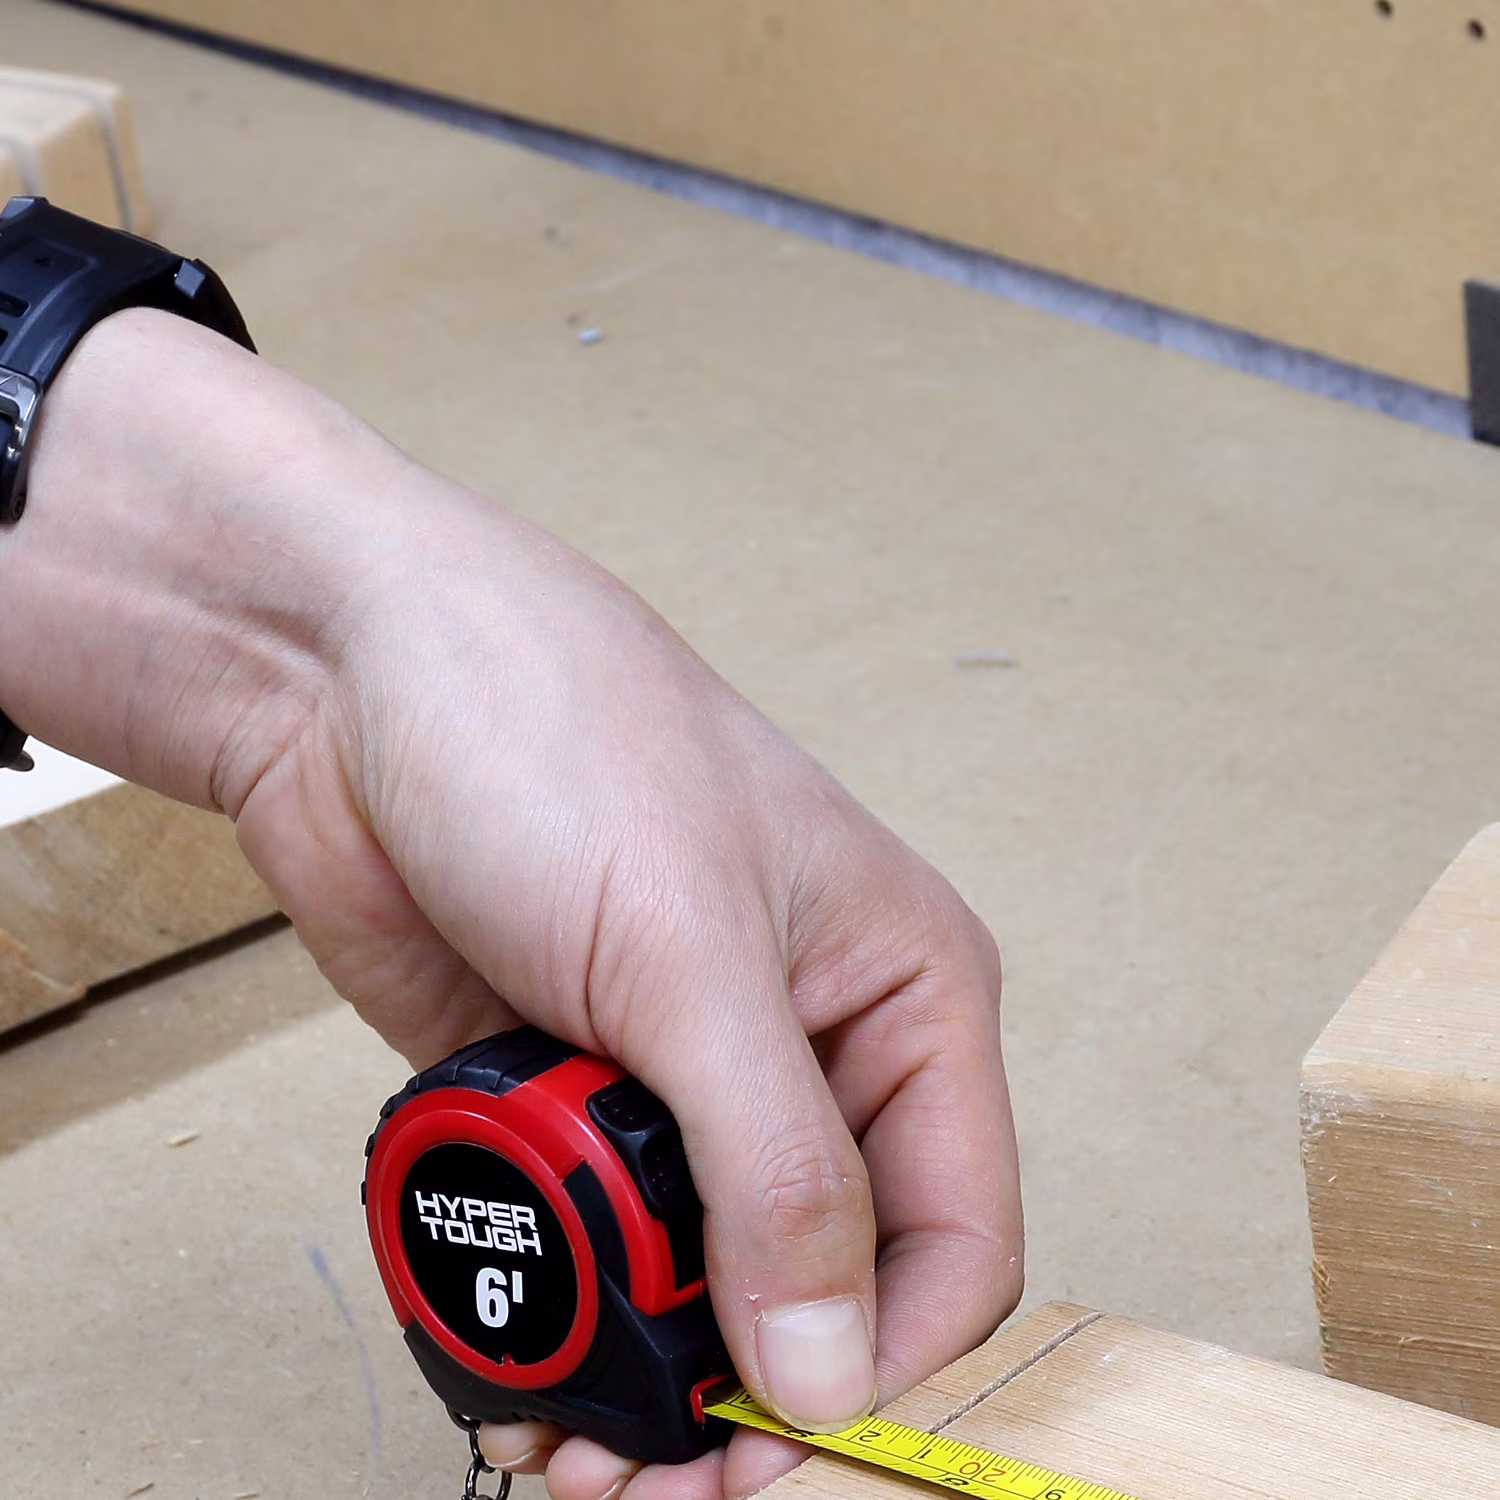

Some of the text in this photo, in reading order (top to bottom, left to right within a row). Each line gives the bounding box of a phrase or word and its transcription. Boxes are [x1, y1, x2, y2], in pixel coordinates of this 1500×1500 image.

[415, 1190, 538, 1231] HYPER
[419, 1215, 543, 1256] TOUGH
[475, 1267, 524, 1328] 6'
[859, 1430, 881, 1443] 2
[918, 1448, 932, 1460] 1
[959, 1461, 1007, 1482] 20
[1045, 1488, 1066, 1500] 9
